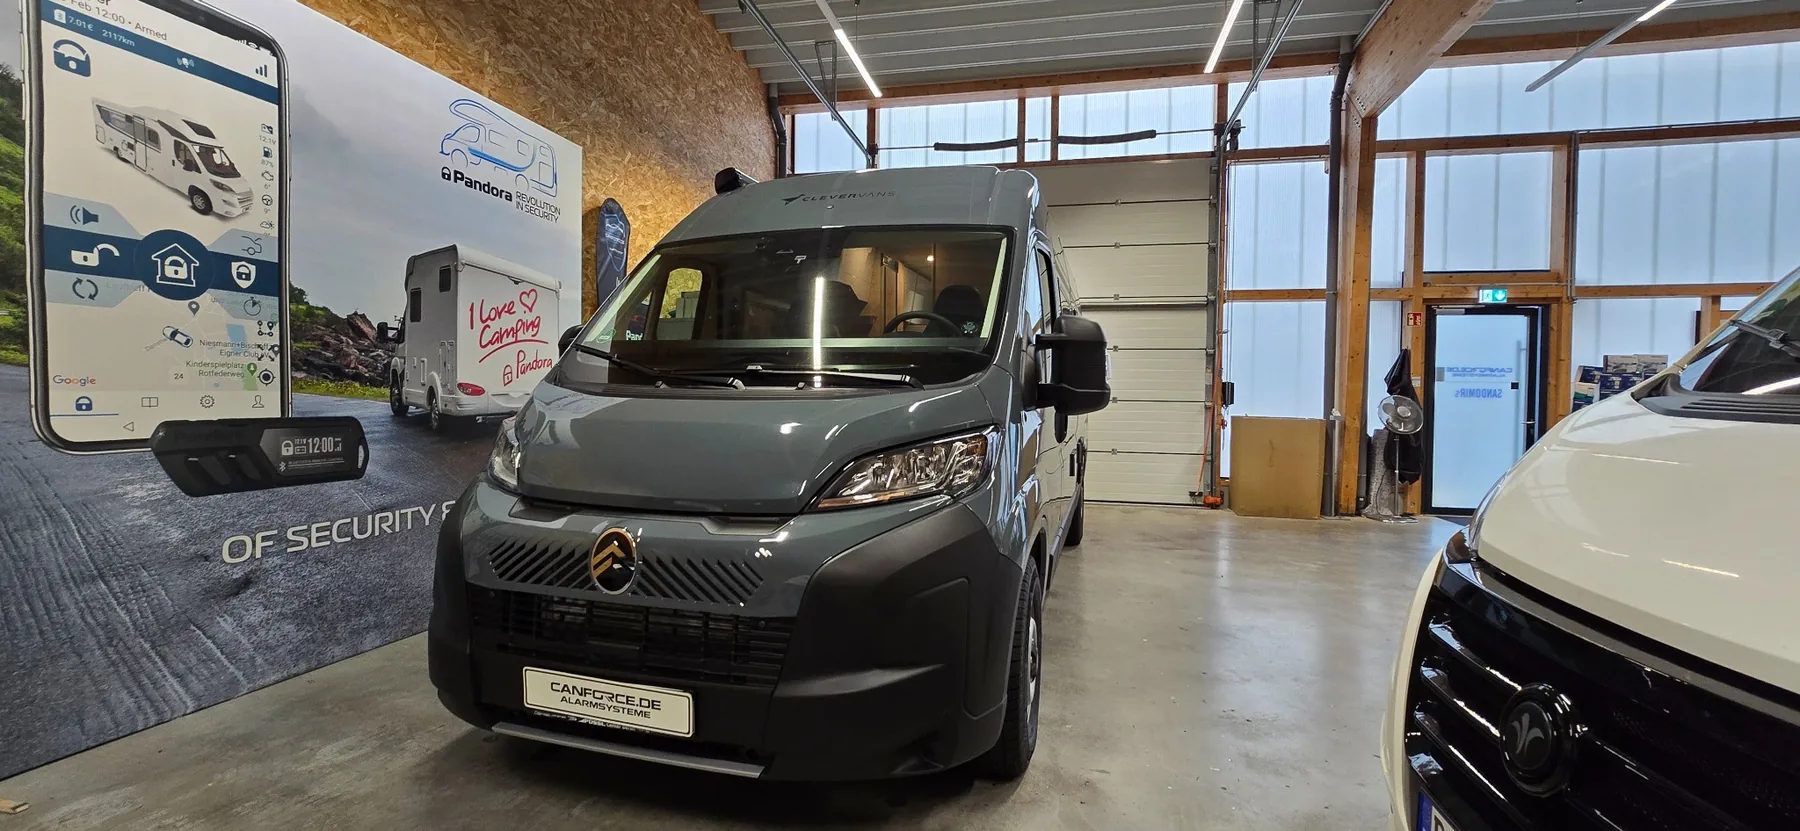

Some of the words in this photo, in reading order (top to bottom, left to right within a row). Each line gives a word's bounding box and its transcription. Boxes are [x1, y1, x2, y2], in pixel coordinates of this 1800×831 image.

[68, 15, 94, 31] 7.01€
[102, 29, 136, 47] 2117km
[70, 0, 92, 12] Feb
[95, 6, 125, 24] 12:00
[134, 22, 168, 41] Armed
[453, 169, 513, 202] Pandora
[802, 190, 896, 202] CLEVERVANS
[515, 190, 561, 216] REVOLUTION
[515, 201, 524, 211] IN
[524, 204, 559, 223] SECURITY
[479, 299, 517, 324] Love
[479, 311, 541, 349] Camping
[186, 360, 245, 370] Kinderspielplatz
[220, 350, 242, 358] Eigner
[243, 350, 259, 358] Club
[516, 349, 553, 379] Pandora
[52, 374, 96, 387] Google
[199, 370, 245, 379] Rotfederweg
[307, 436, 334, 454] 12:00
[221, 529, 279, 564] OF
[286, 503, 437, 553] SECURITY
[551, 682, 661, 711] CANFORCE.DE
[560, 696, 652, 719] ALARMSYSTEME
